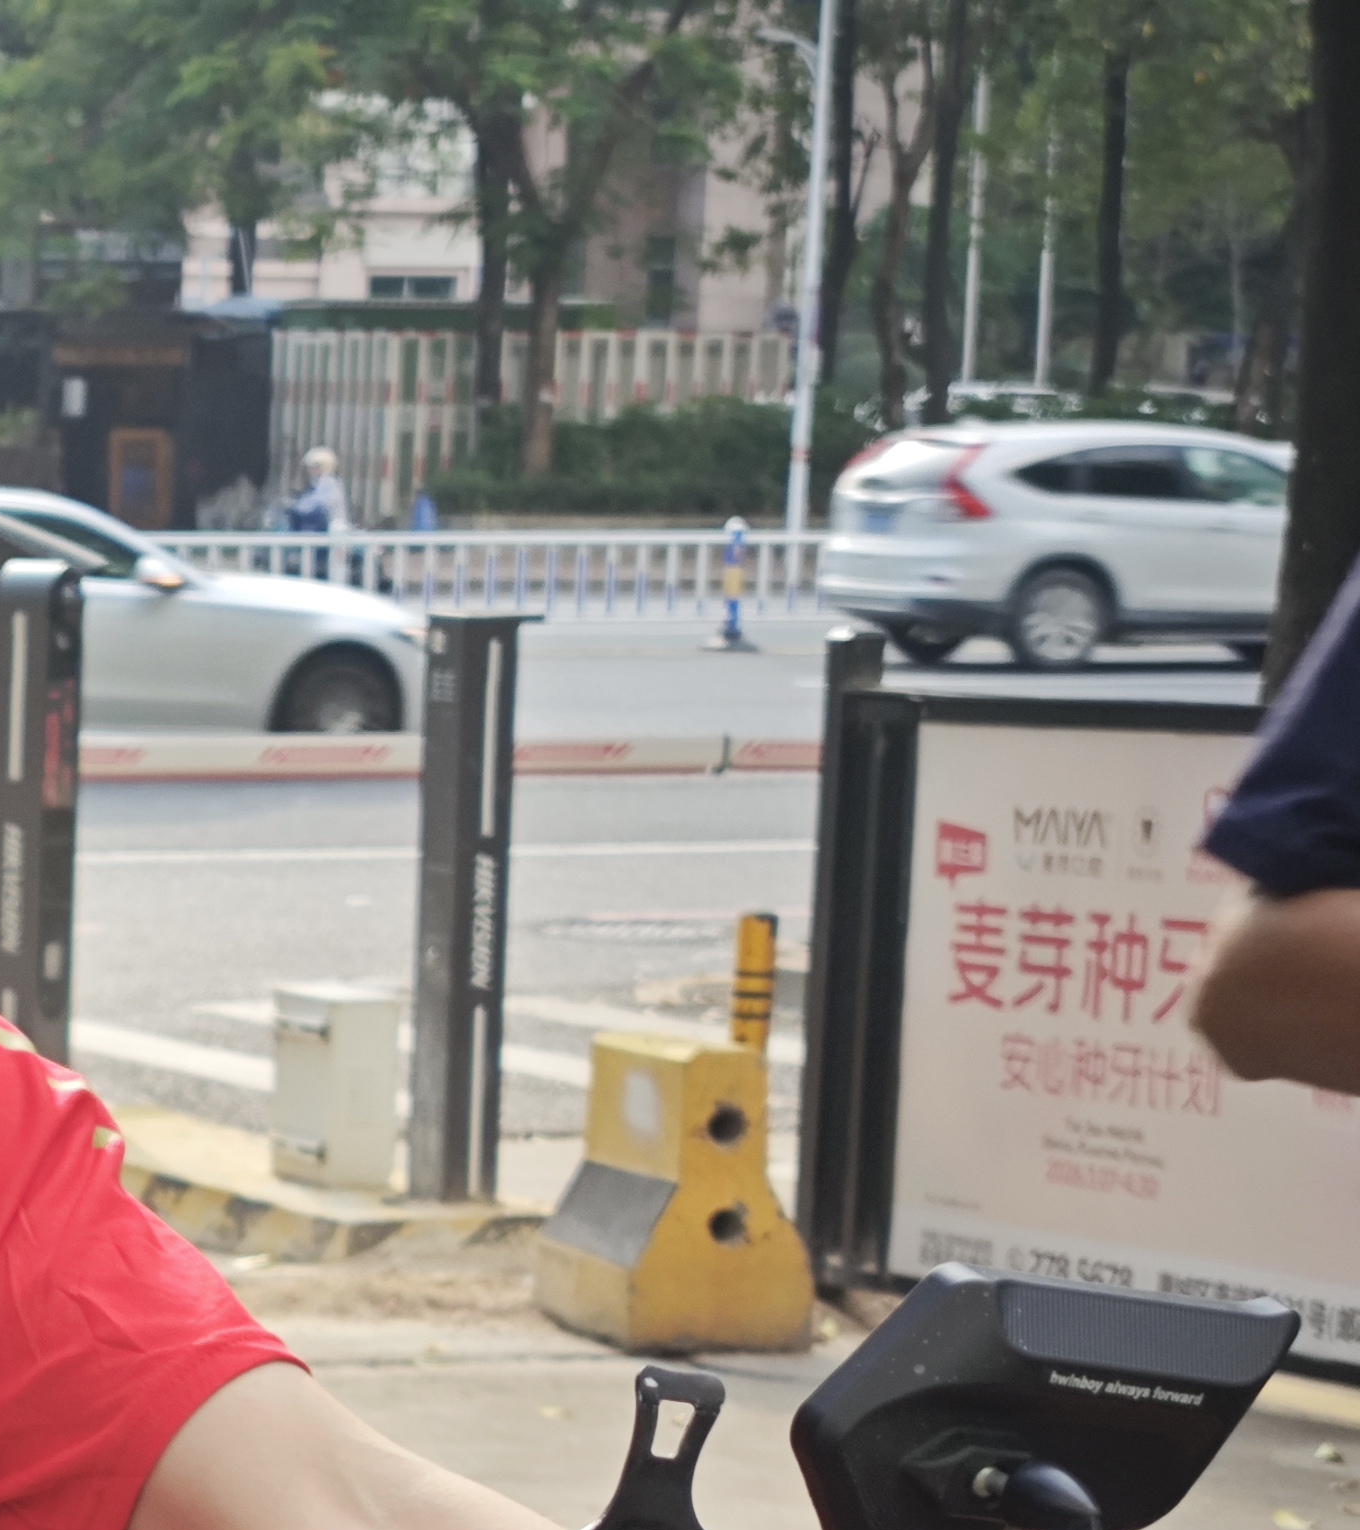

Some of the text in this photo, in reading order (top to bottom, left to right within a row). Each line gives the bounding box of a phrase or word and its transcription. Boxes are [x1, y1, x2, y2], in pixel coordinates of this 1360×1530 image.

[470, 852, 498, 991] HIKVISION
[947, 898, 1208, 1024] 麦芽种牙
[998, 1032, 1221, 1118] 安心种牙计划
[1104, 1380, 1152, 1401] always
[1152, 1386, 1205, 1407] forward
